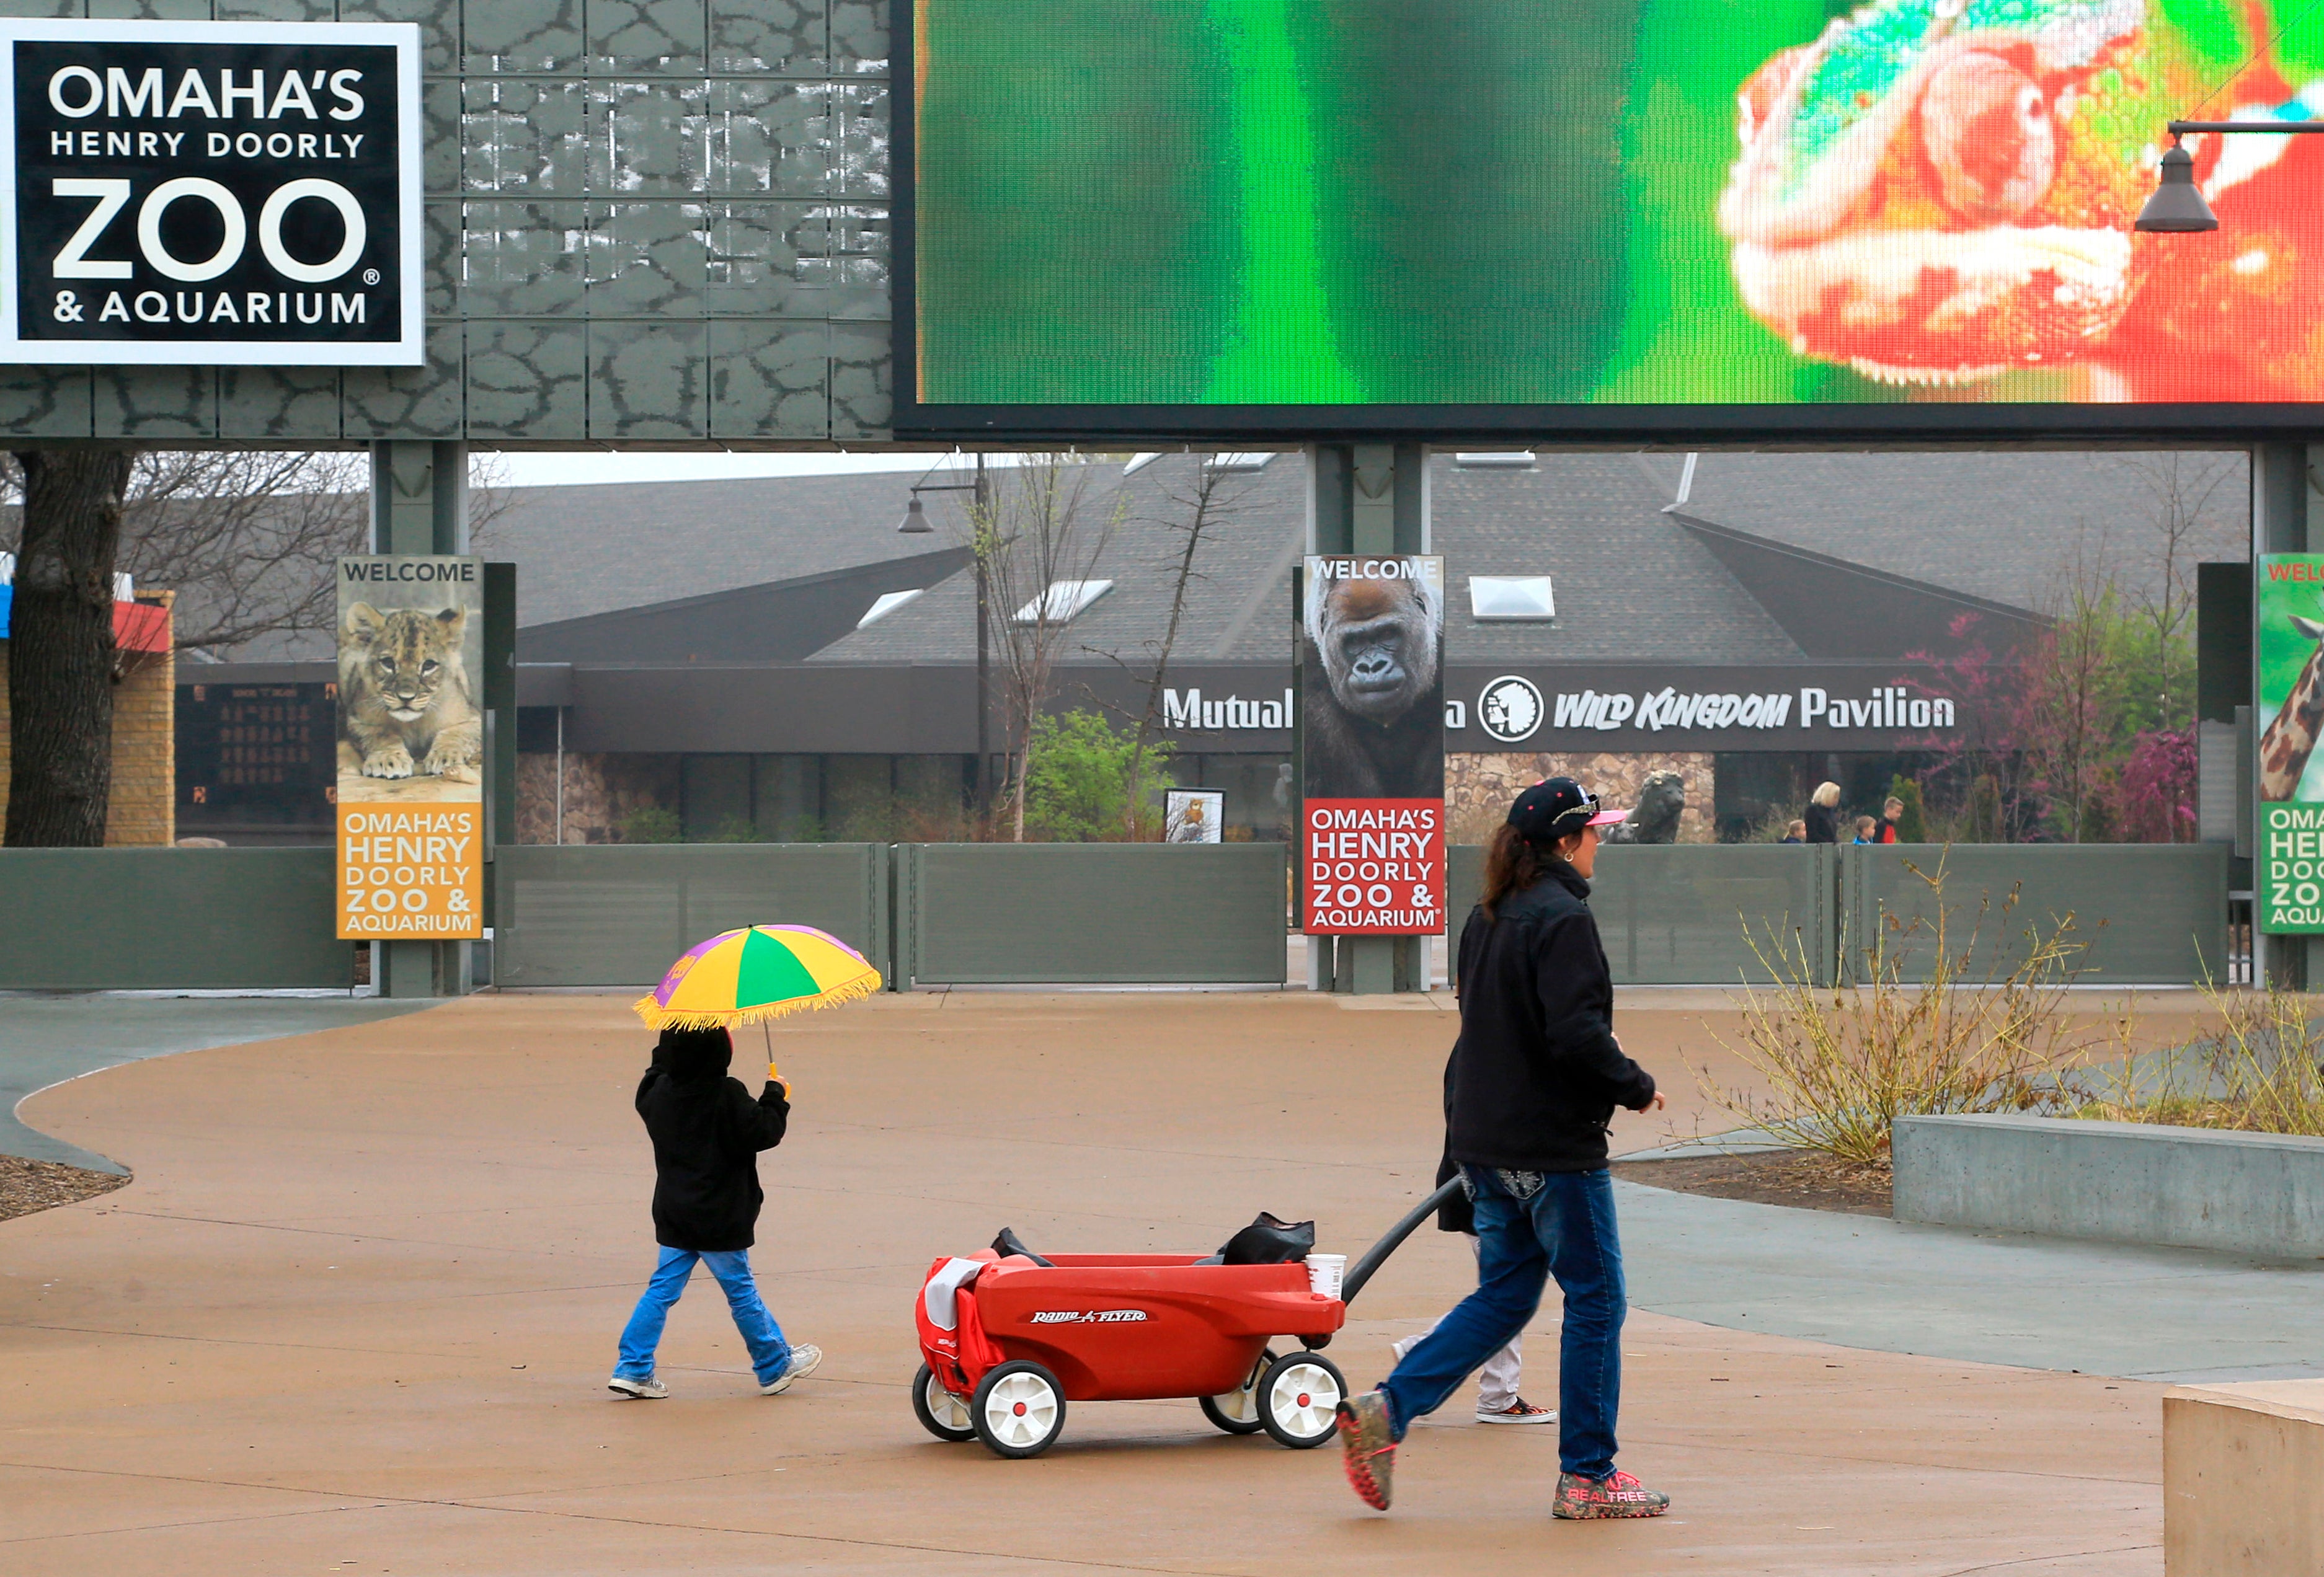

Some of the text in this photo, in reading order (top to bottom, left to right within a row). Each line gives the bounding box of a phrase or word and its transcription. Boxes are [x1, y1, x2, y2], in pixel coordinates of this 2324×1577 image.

[48, 64, 365, 121] OMAHA'S
[51, 131, 364, 158] HENRY DOORLY
[53, 289, 366, 324] & AQUARIUM
[344, 563, 474, 581] WELCOME
[1310, 560, 1437, 580] WELCOME
[2267, 563, 2324, 581] WEL
[1163, 687, 1293, 729] Mutual
[1553, 689, 1635, 731] WILD
[1634, 686, 1793, 731] KINGDOM
[1800, 687, 1955, 728] Pavilion
[344, 812, 472, 833] OMAHA'S
[1311, 808, 1435, 829] OMAHA'S
[345, 836, 471, 863] HENRY
[1312, 832, 1434, 859] HENRY
[2271, 832, 2324, 858] HE
[346, 866, 470, 886] DOORLY
[1313, 862, 1434, 881] DOORLY
[345, 888, 471, 912] ZOO &
[1313, 883, 1434, 908] ZOO &
[2271, 908, 2324, 925] AQU
[1030, 1309, 1148, 1323] RADIO FLYER
[1568, 1488, 1647, 1503] REALTREE
